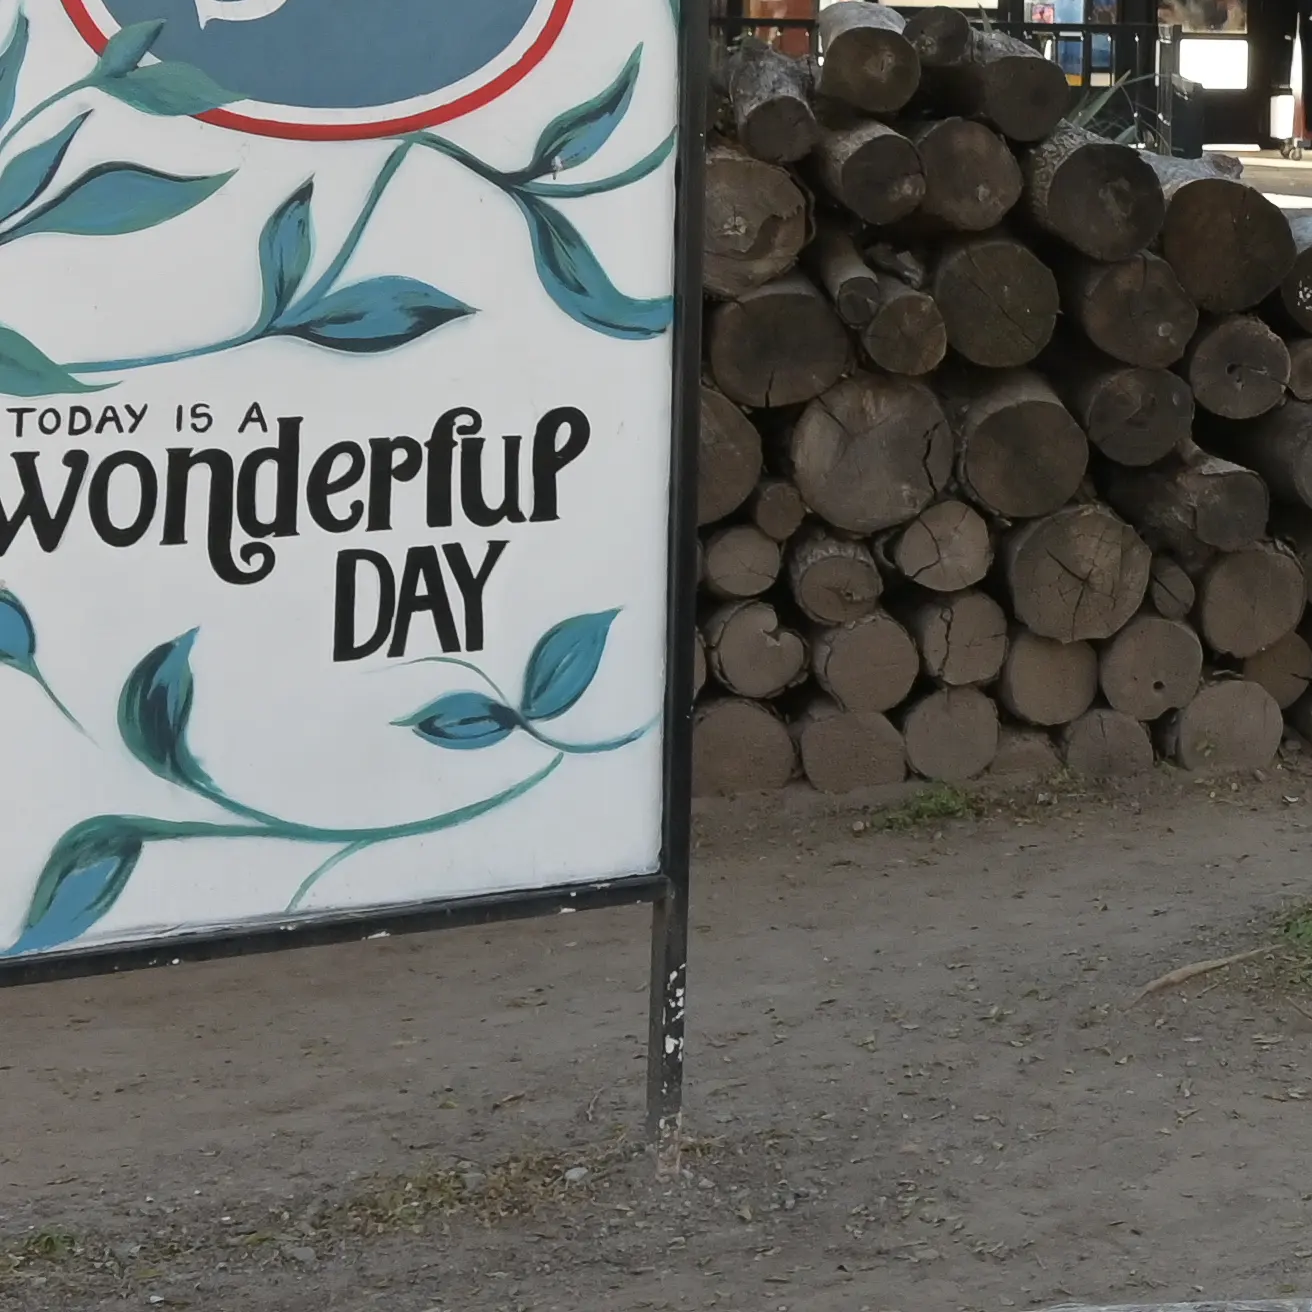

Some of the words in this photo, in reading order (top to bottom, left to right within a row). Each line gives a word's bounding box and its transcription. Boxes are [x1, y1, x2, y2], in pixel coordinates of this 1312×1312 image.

[6, 402, 149, 438] TODAY
[175, 402, 213, 433] IS
[237, 400, 268, 433] A
[332, 539, 511, 662] DAY
